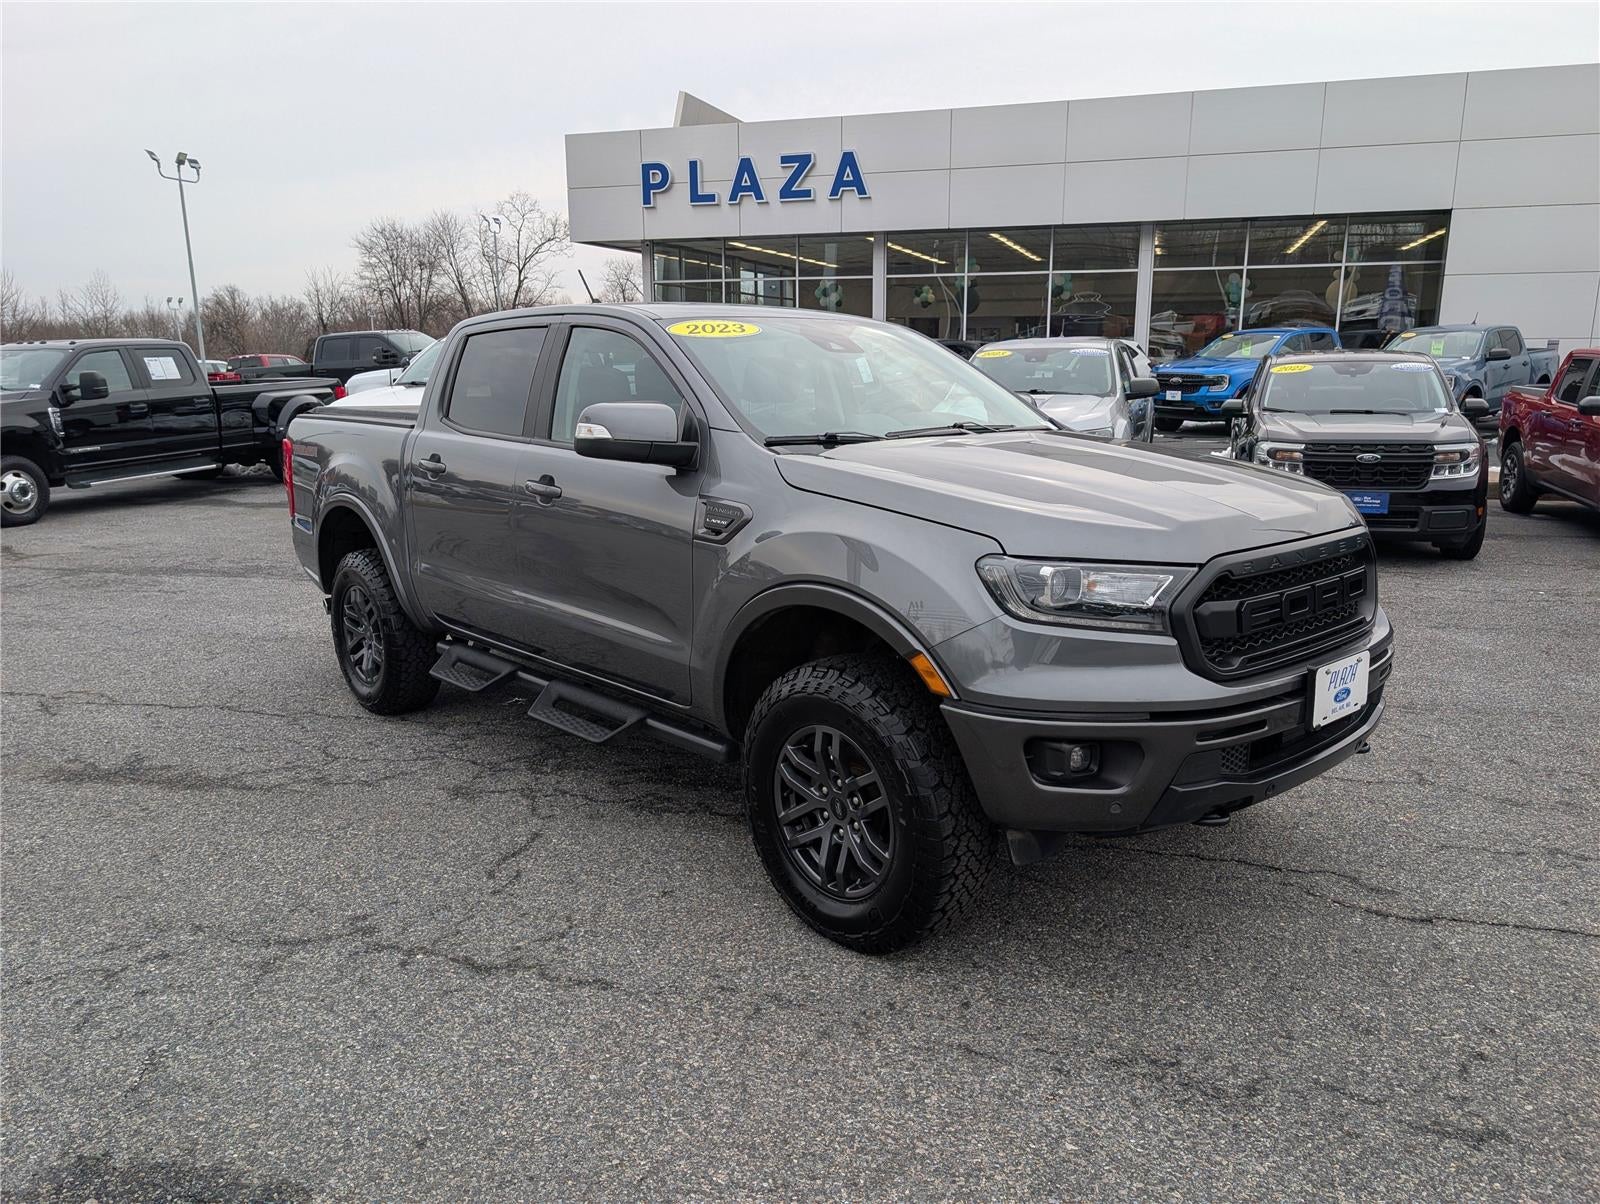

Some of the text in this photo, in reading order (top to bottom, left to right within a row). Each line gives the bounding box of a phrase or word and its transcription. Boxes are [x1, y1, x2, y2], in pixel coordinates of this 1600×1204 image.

[640, 150, 872, 208] PLAZA
[686, 323, 746, 335] 2023
[1241, 567, 1368, 633] FORD
[1327, 663, 1359, 692] PLAZA
